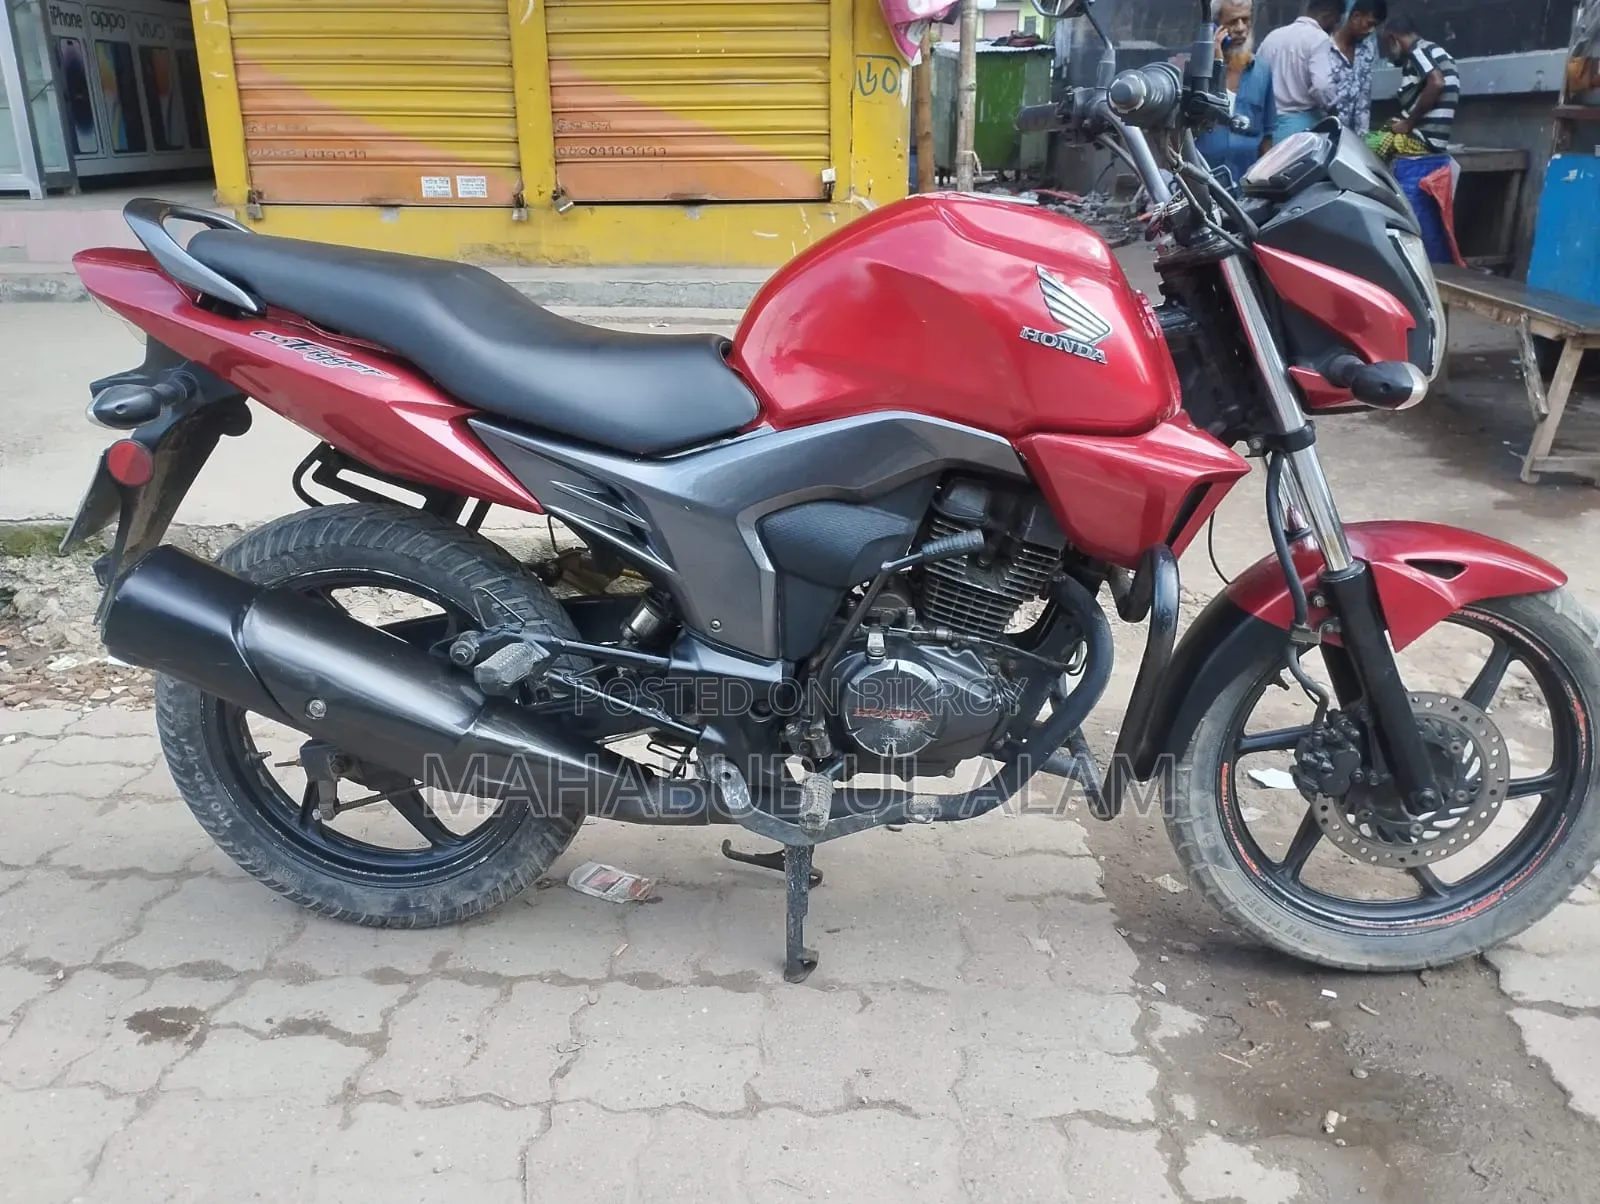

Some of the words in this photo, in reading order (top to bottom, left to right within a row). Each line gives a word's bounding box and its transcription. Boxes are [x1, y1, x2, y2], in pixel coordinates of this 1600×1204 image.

[49, 5, 83, 29] iPhone
[91, 11, 126, 33] oppo
[1019, 325, 1109, 365] HONDA
